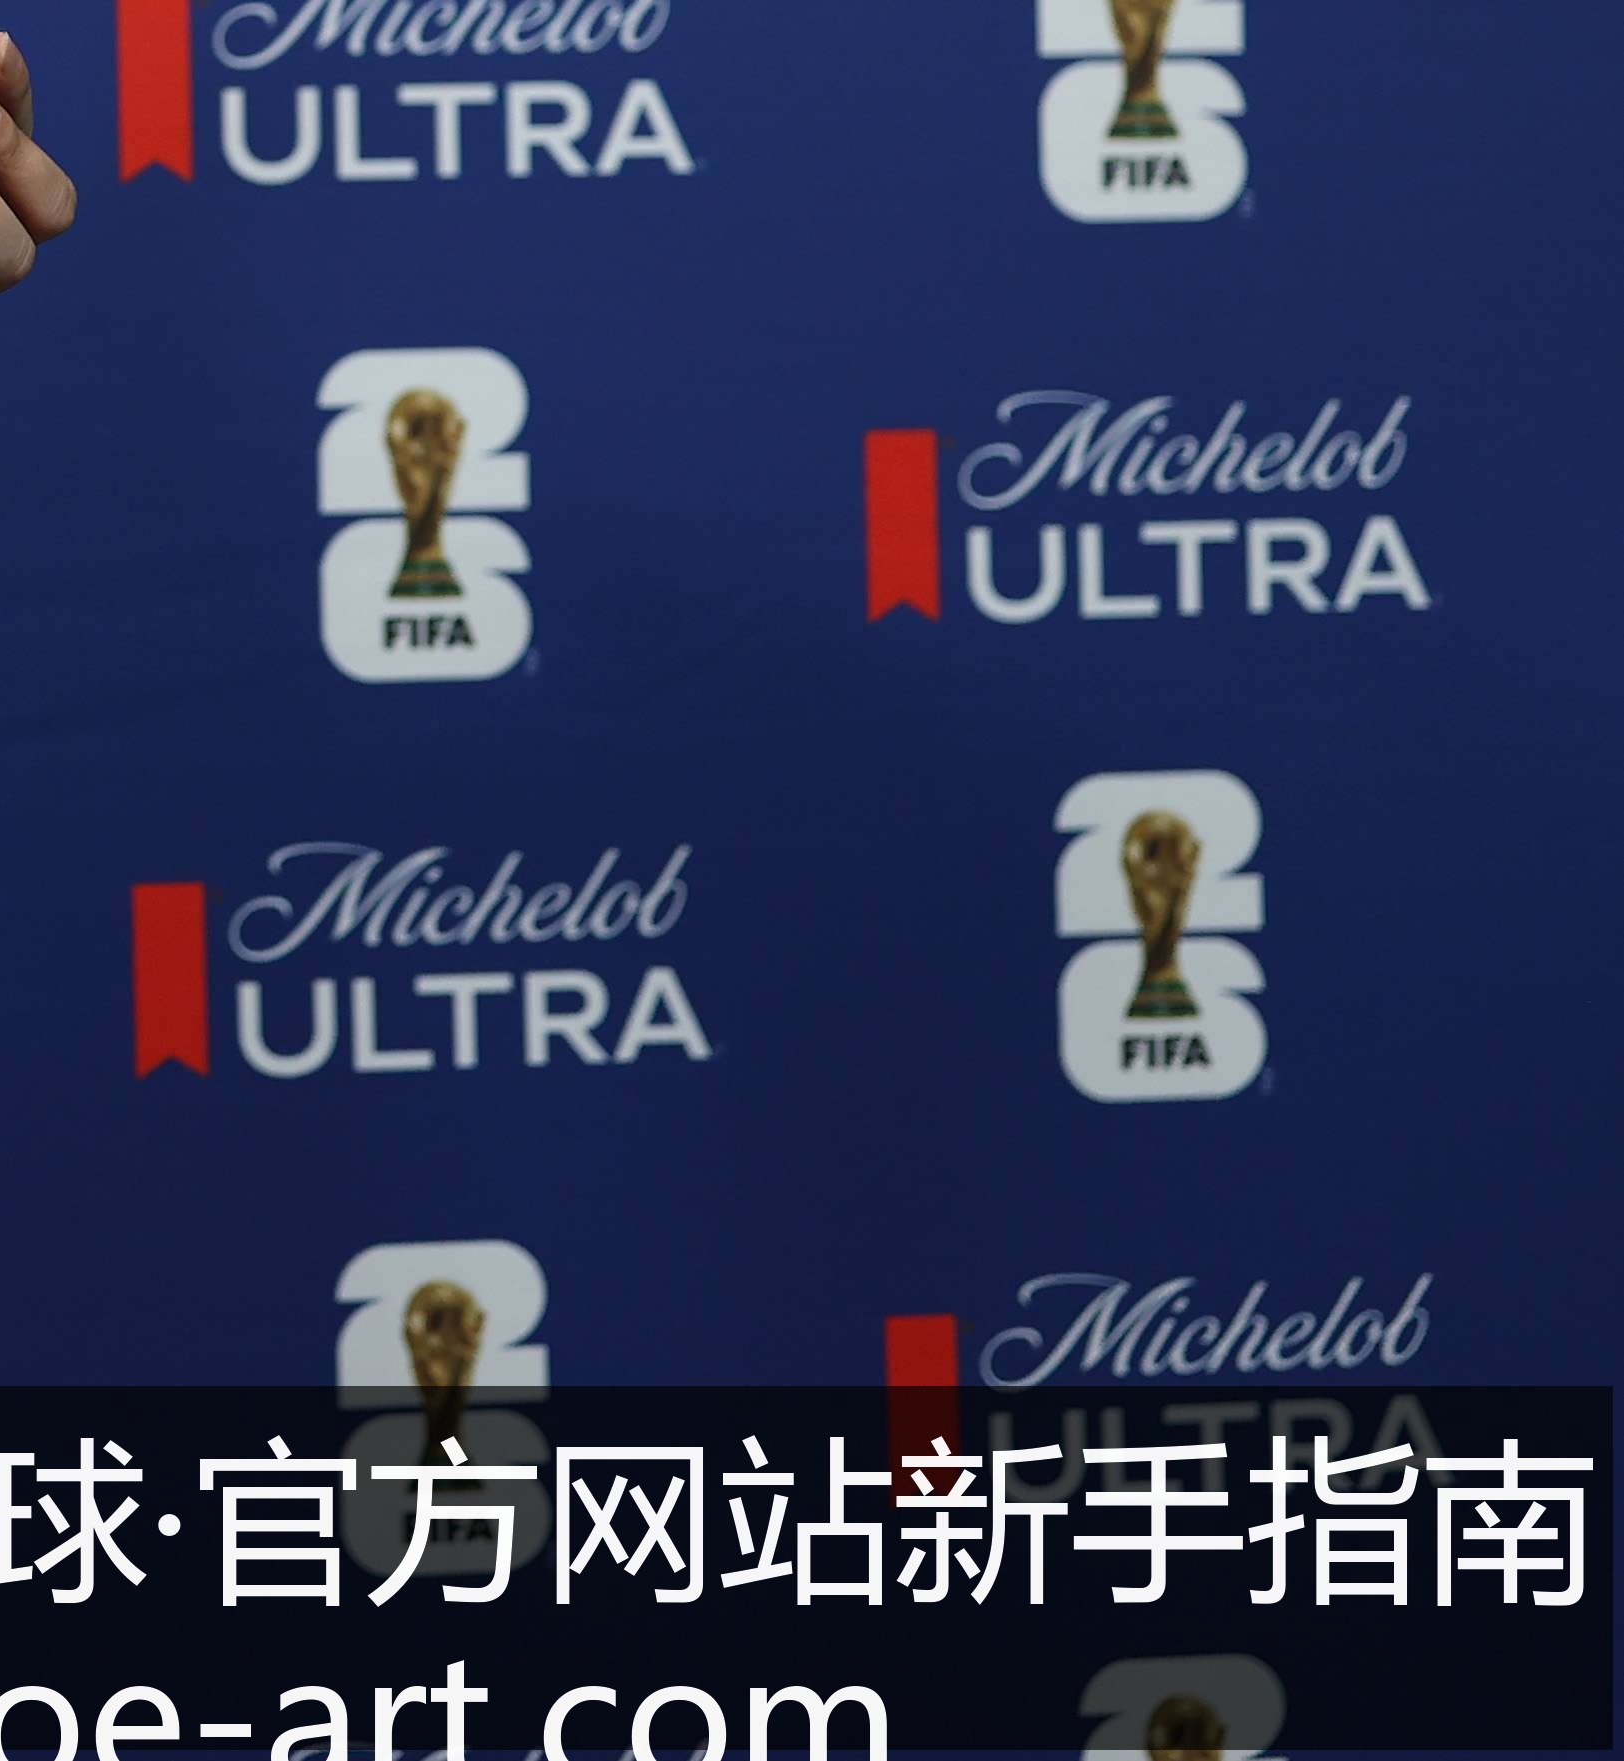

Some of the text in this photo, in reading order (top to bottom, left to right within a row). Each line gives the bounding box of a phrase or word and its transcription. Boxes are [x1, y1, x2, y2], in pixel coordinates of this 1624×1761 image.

[221, 79, 693, 185] ULTRA
[1102, 156, 1190, 188] FIFA
[960, 390, 1410, 510] Michelob
[966, 517, 1428, 623] ULTRA
[383, 615, 475, 649] FIFA
[229, 842, 690, 962] Michelob
[237, 966, 710, 1078] ULTRA
[1121, 1034, 1211, 1070] FIFA
[981, 1272, 1434, 1392] Michelob
